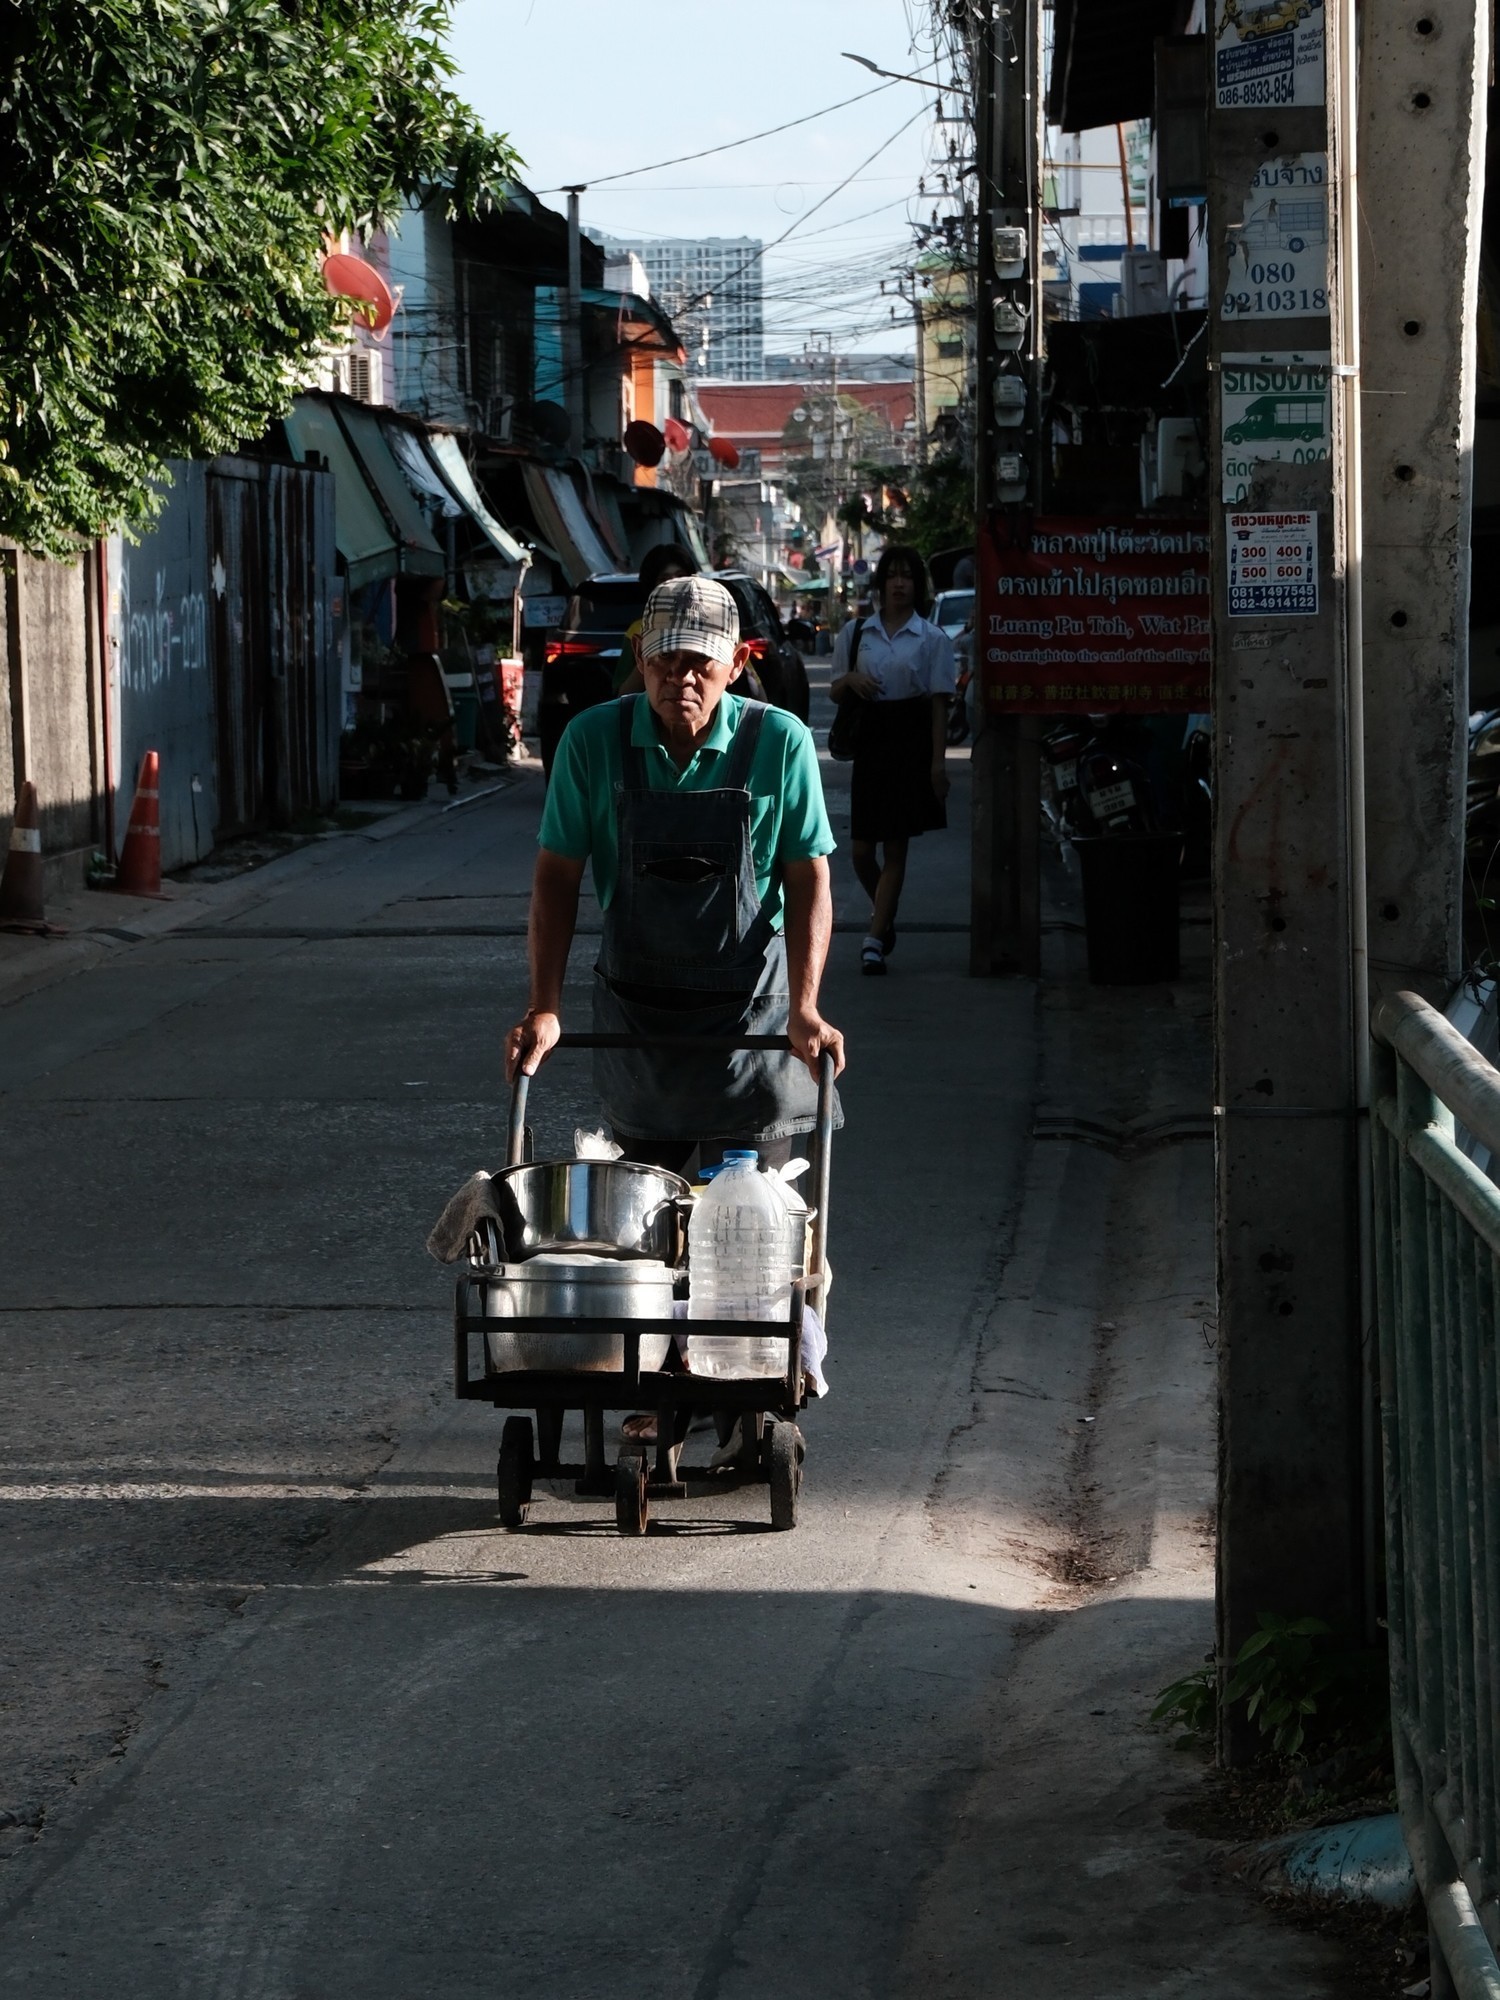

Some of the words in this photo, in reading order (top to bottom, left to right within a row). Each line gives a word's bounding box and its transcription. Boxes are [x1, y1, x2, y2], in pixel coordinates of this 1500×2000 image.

[1219, 72, 1295, 105] 086-8933-854
[1251, 263, 1295, 284] 080
[1223, 288, 1326, 314] 9210318
[1241, 547, 1266, 558] 300
[1276, 546, 1302, 557] 400
[1241, 567, 1267, 578] 500
[1277, 566, 1302, 577] 600
[1231, 585, 1314, 598] 081-1497545
[1231, 597, 1315, 609] 082-4914122
[989, 615, 1054, 639] Luang
[1055, 615, 1084, 635] Pu
[1088, 615, 1134, 640] Toh,
[1137, 615, 1181, 635] Wat
[1183, 614, 1210, 635] Pr
[987, 648, 1009, 663] Go
[1010, 648, 1059, 665] straight
[1060, 649, 1077, 663] to
[1077, 648, 1099, 663] the
[1100, 648, 1124, 663] end
[1125, 648, 1142, 663] of
[1142, 648, 1165, 663] the
[1166, 648, 1198, 665] alley
